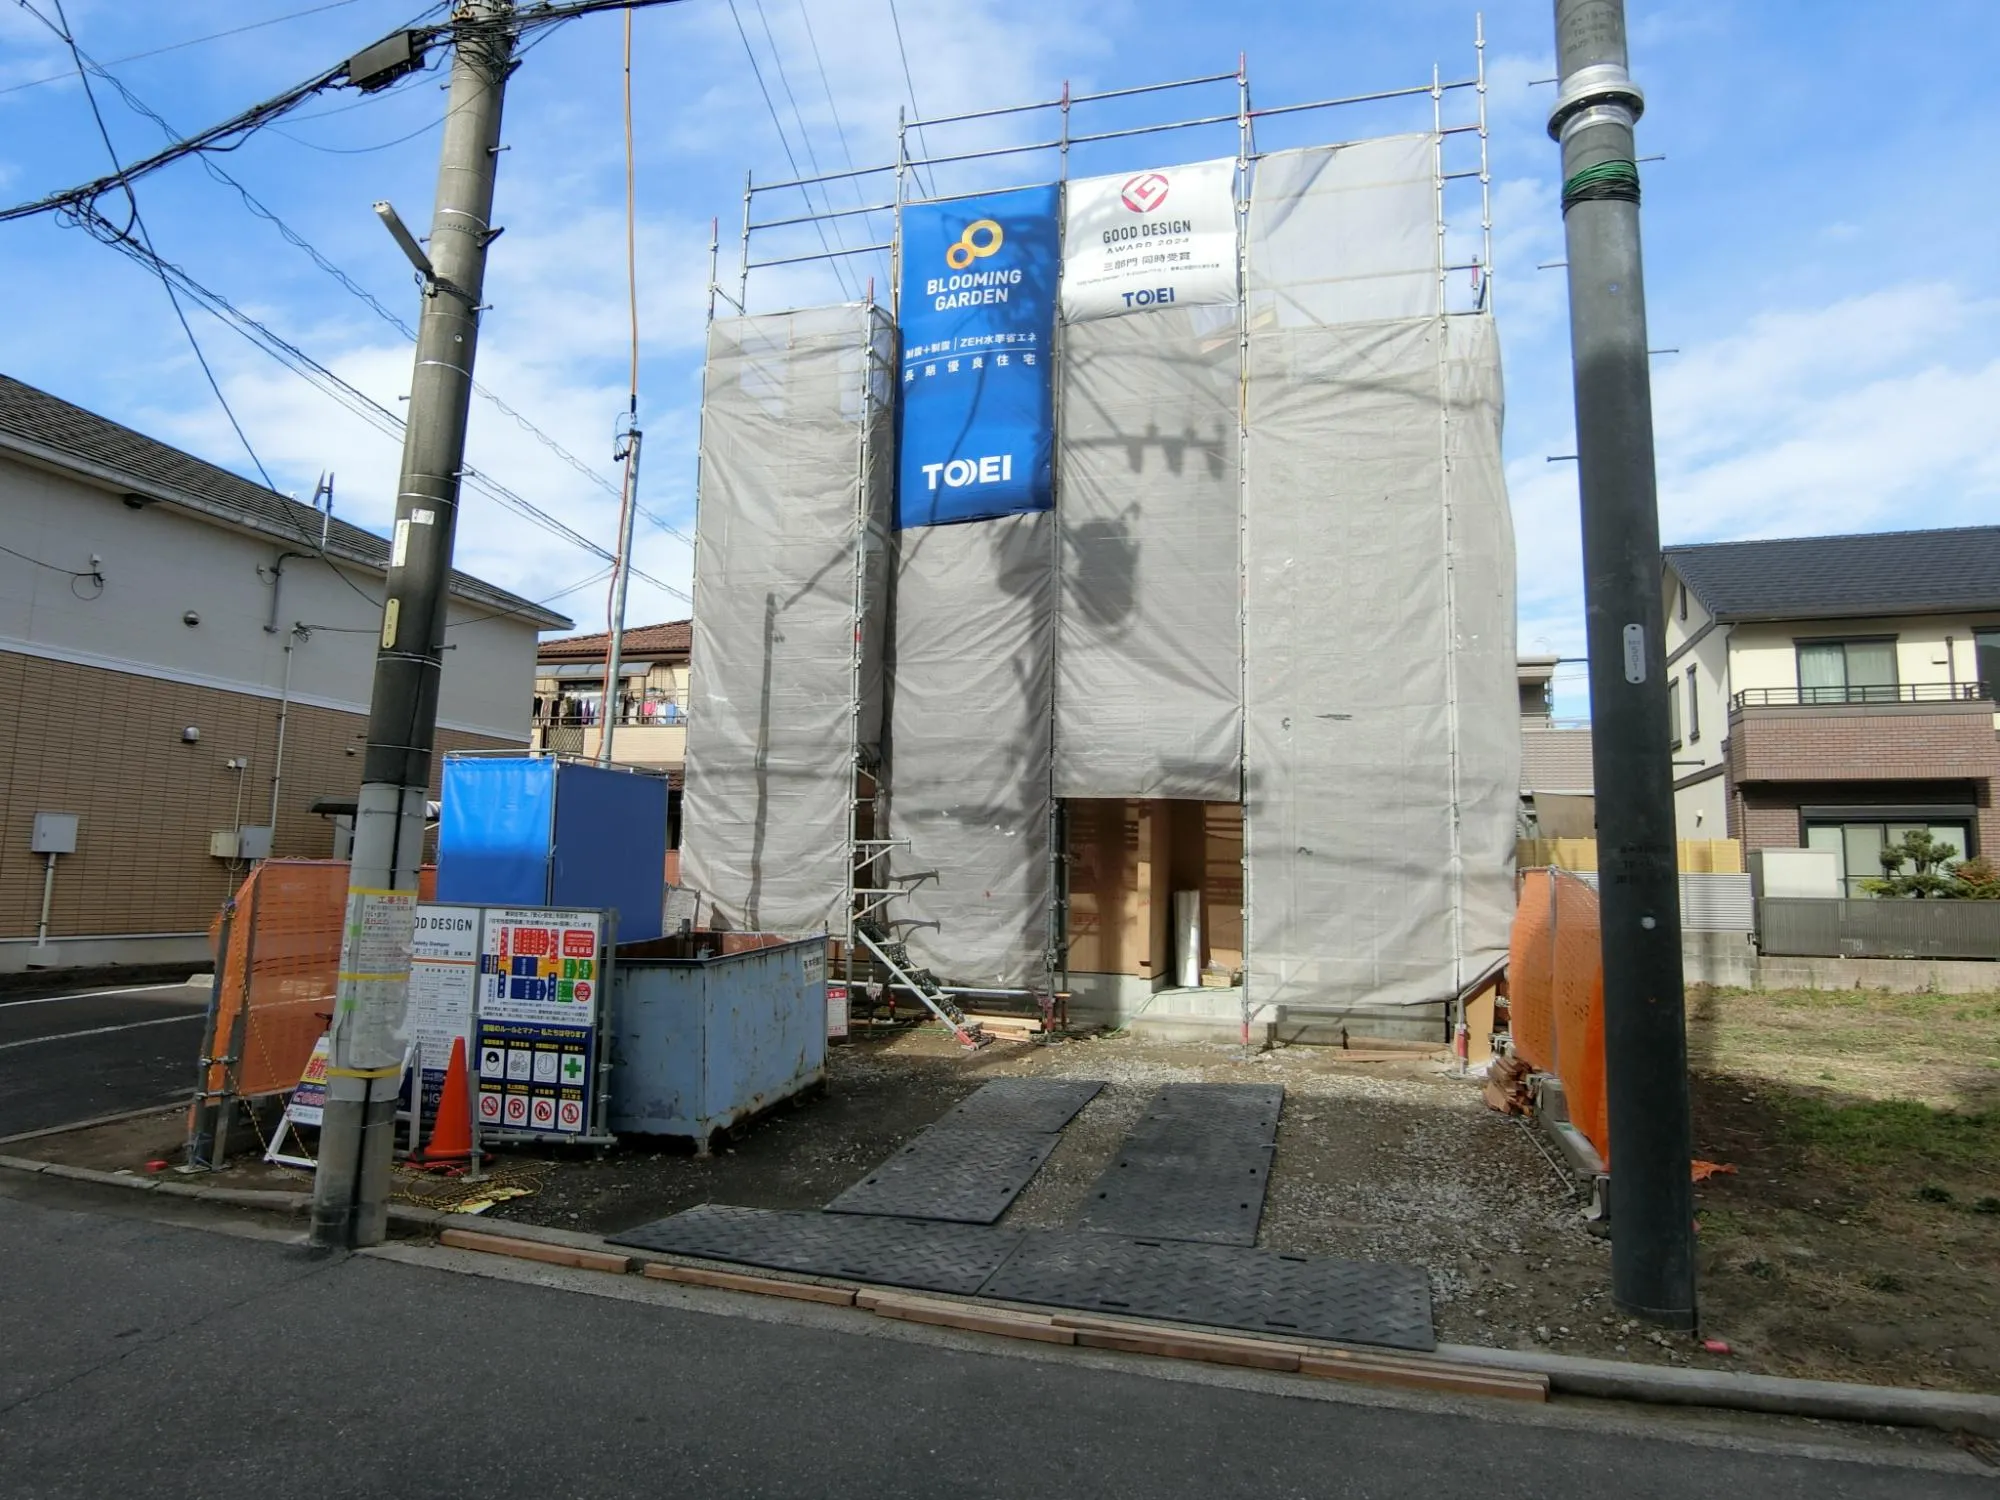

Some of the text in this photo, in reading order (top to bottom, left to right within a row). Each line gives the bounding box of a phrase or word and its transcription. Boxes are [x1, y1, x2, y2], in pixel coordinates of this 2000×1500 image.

[1103, 220, 1192, 244] GOOD DESIGN
[1106, 237, 1189, 254] AWARD 2024
[1103, 251, 1191, 271] 三部門 同時受賞
[926, 269, 1022, 295] BLOOMING
[935, 288, 1008, 311] GARDEN
[431, 917, 473, 931] DESIGN
